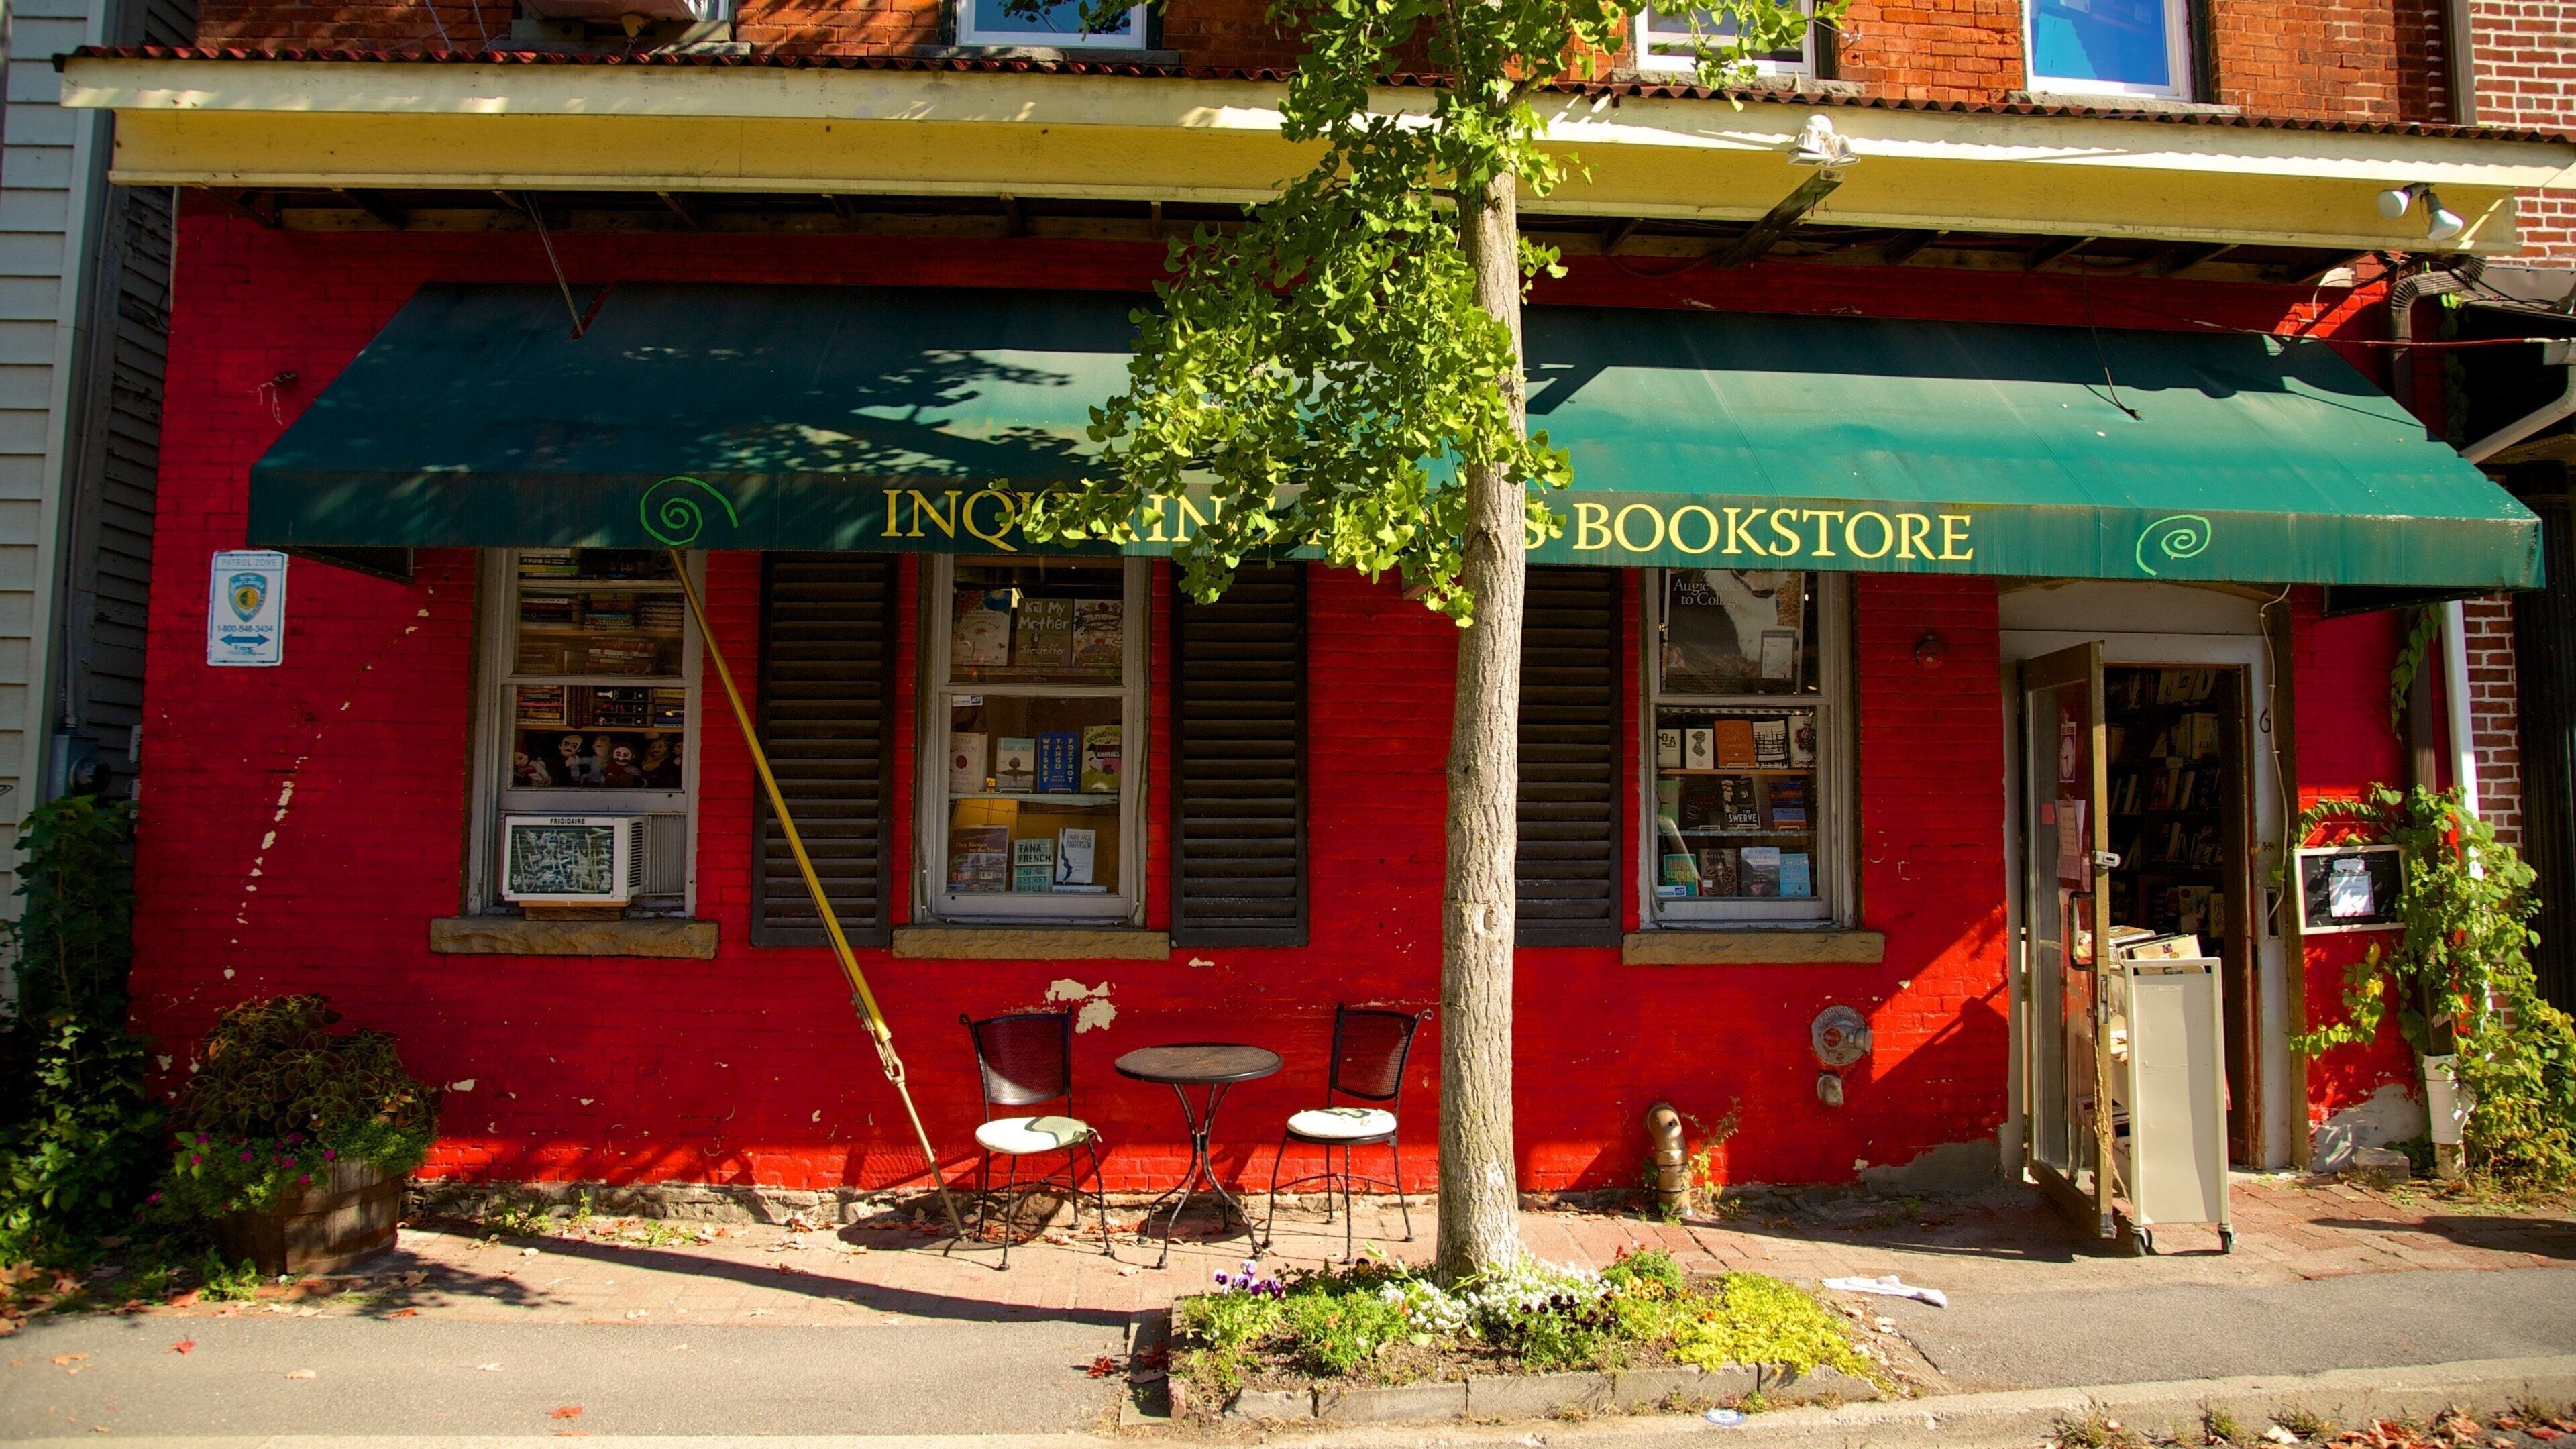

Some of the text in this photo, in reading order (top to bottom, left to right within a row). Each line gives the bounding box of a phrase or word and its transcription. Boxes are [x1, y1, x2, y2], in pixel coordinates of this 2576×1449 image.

[881, 489, 1276, 552] INQIN
[1573, 502, 1974, 561] BOOKSTORE
[1672, 578, 1745, 596] Augie Goes
[1681, 592, 1740, 609] to College
[1024, 602, 1065, 616] Kill My
[1018, 616, 1071, 631] Mother
[1020, 645, 1039, 655] Jules
[1721, 726, 1746, 735] ONE
[1042, 738, 1051, 782] WHISKEY
[1728, 812, 1757, 823] SWERVE
[1018, 844, 1042, 853] TANA
[1066, 840, 1091, 849] ANDERSON
[1018, 854, 1051, 862] FRENCH
